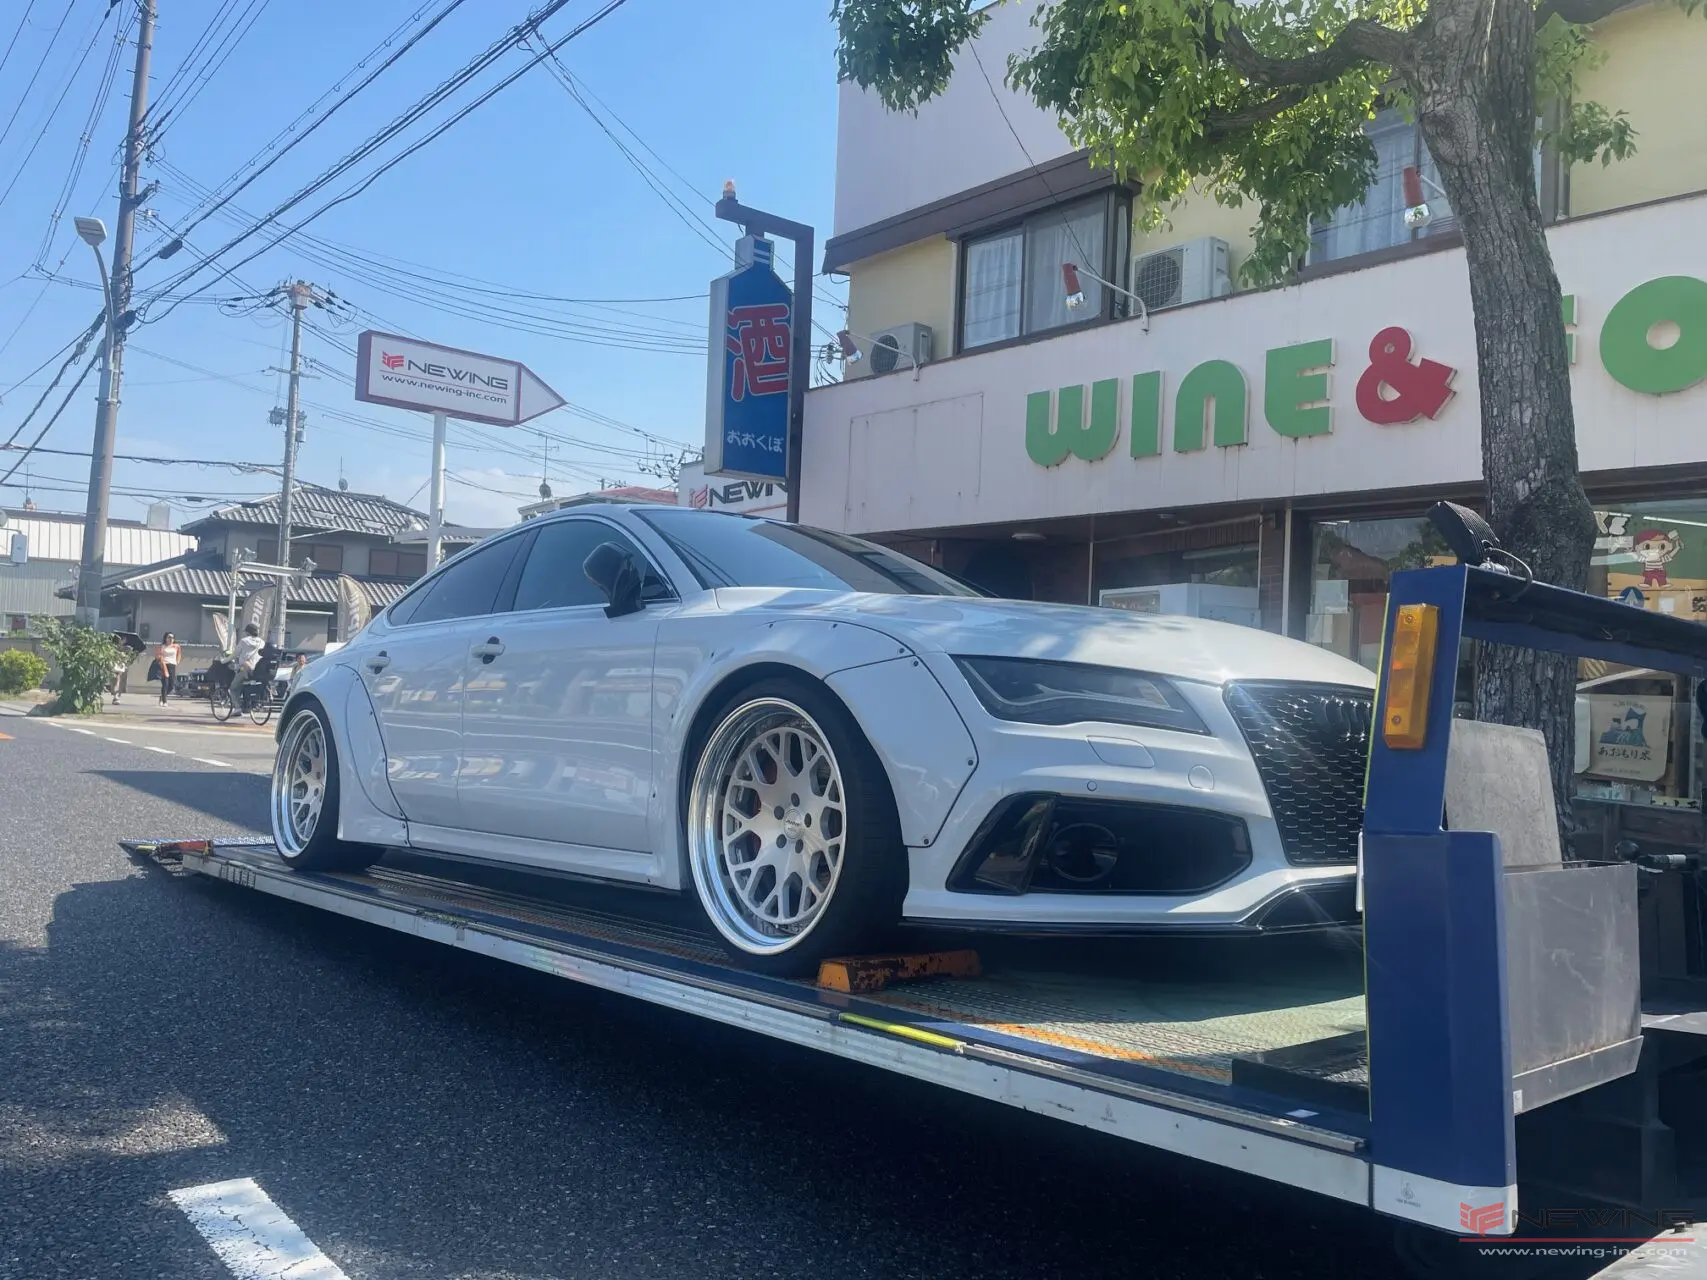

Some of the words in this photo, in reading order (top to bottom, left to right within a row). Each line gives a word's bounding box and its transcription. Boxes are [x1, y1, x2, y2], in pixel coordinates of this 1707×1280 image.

[727, 303, 790, 401] 酒
[408, 360, 508, 390] NEWING
[1025, 338, 1336, 469] WINE
[1356, 326, 1457, 425] &
[1562, 275, 1707, 395] O
[382, 375, 507, 404] www.newing-inc.com
[727, 430, 784, 453] おおくぼ
[709, 481, 788, 507] NEWIN
